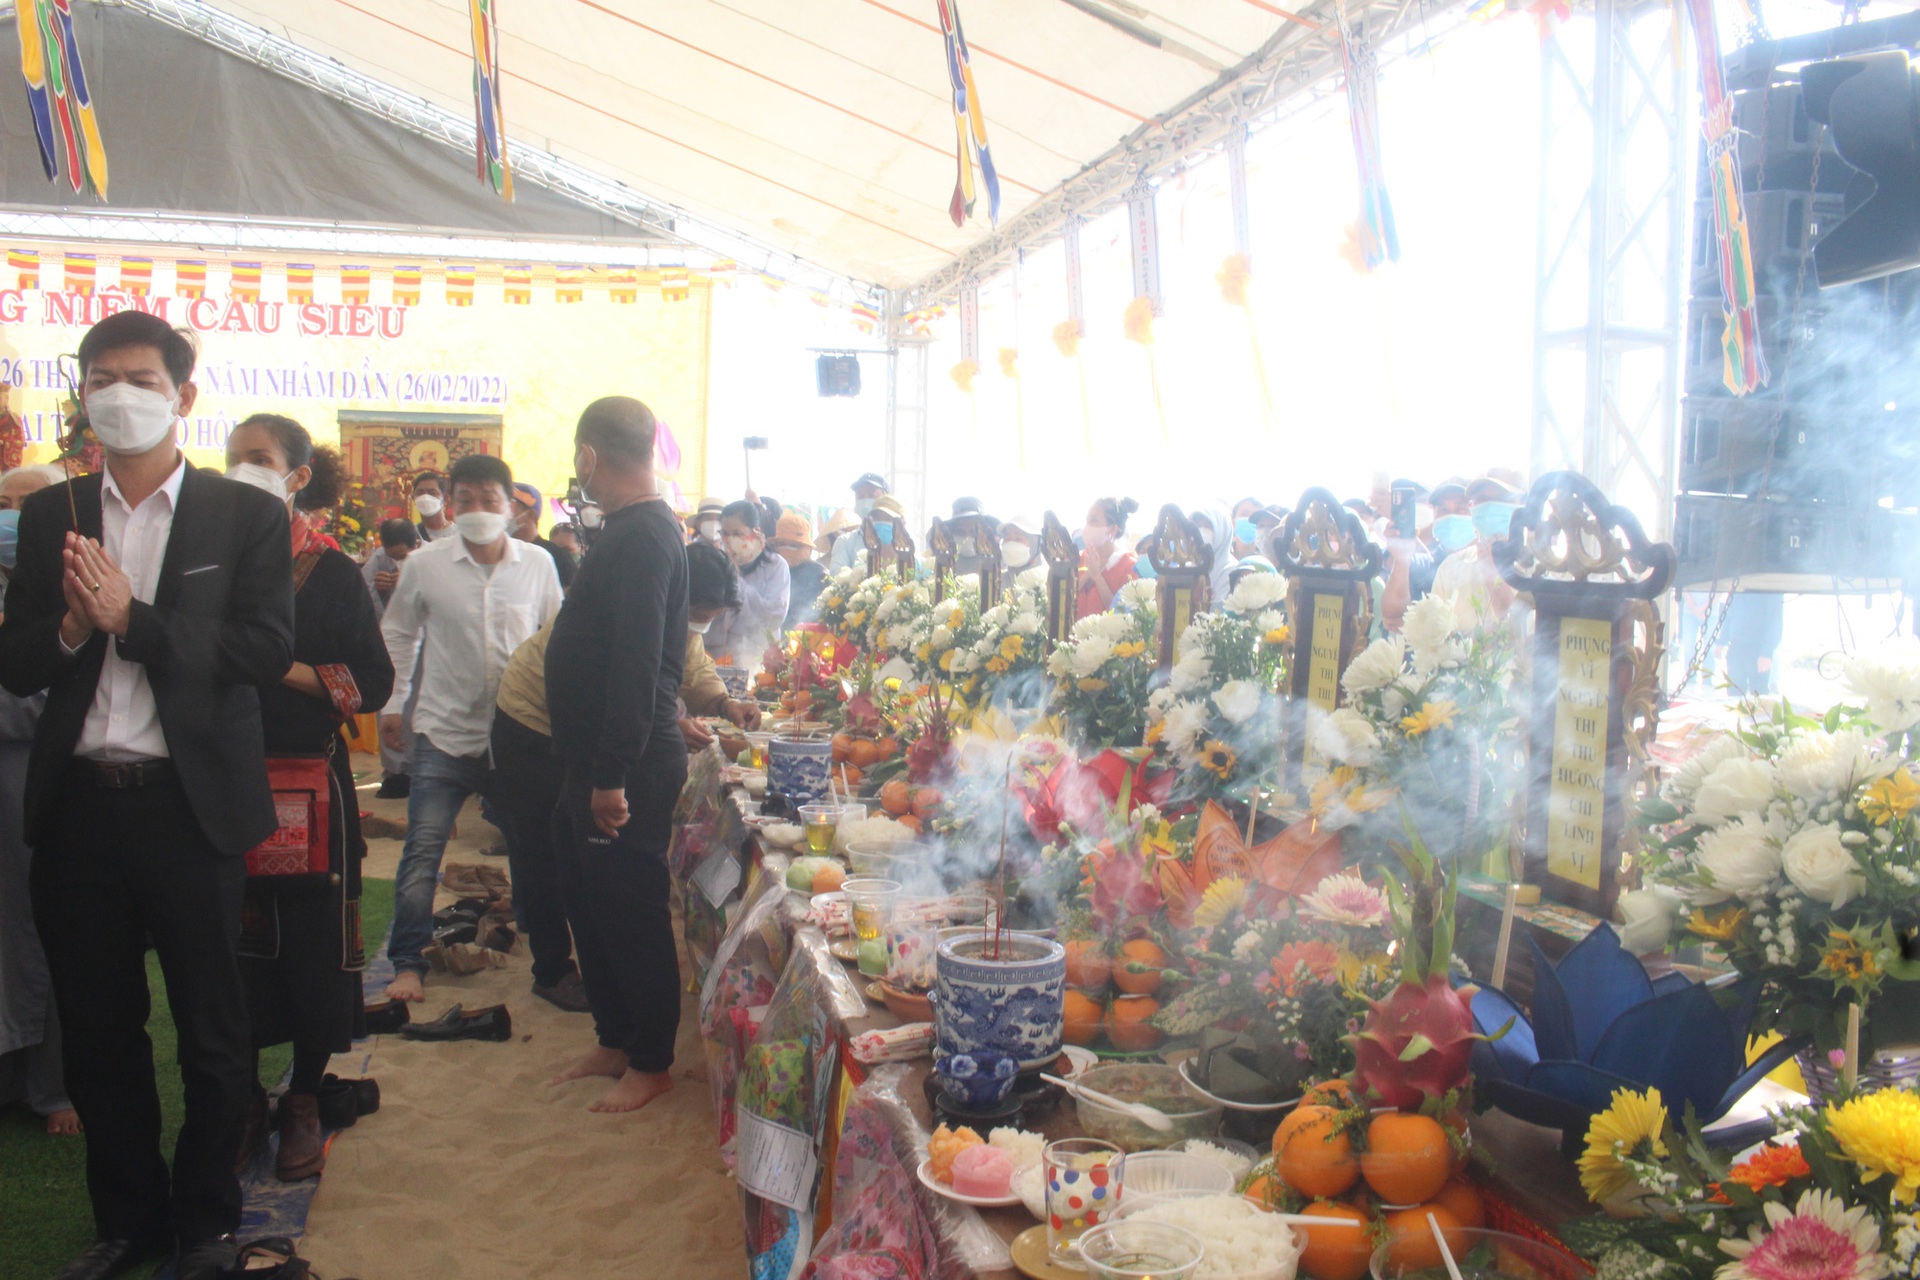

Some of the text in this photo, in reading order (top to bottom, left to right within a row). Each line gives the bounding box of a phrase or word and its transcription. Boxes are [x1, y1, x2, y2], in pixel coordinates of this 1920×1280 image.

[1804, 328, 1815, 341] 15
[1, 358, 24, 388] 26
[205, 360, 259, 395] NĂM
[265, 361, 335, 398] NHÂM
[342, 356, 390, 400] DẦN
[396, 373, 508, 407] (26/02/2022)
[1798, 432, 1806, 444] 8
[1789, 535, 1800, 548] 12
[1566, 635, 1610, 656] PHỤNG
[1574, 715, 1596, 739] THỊ
[1569, 798, 1592, 817] CHI
[1563, 823, 1595, 846] LINH
